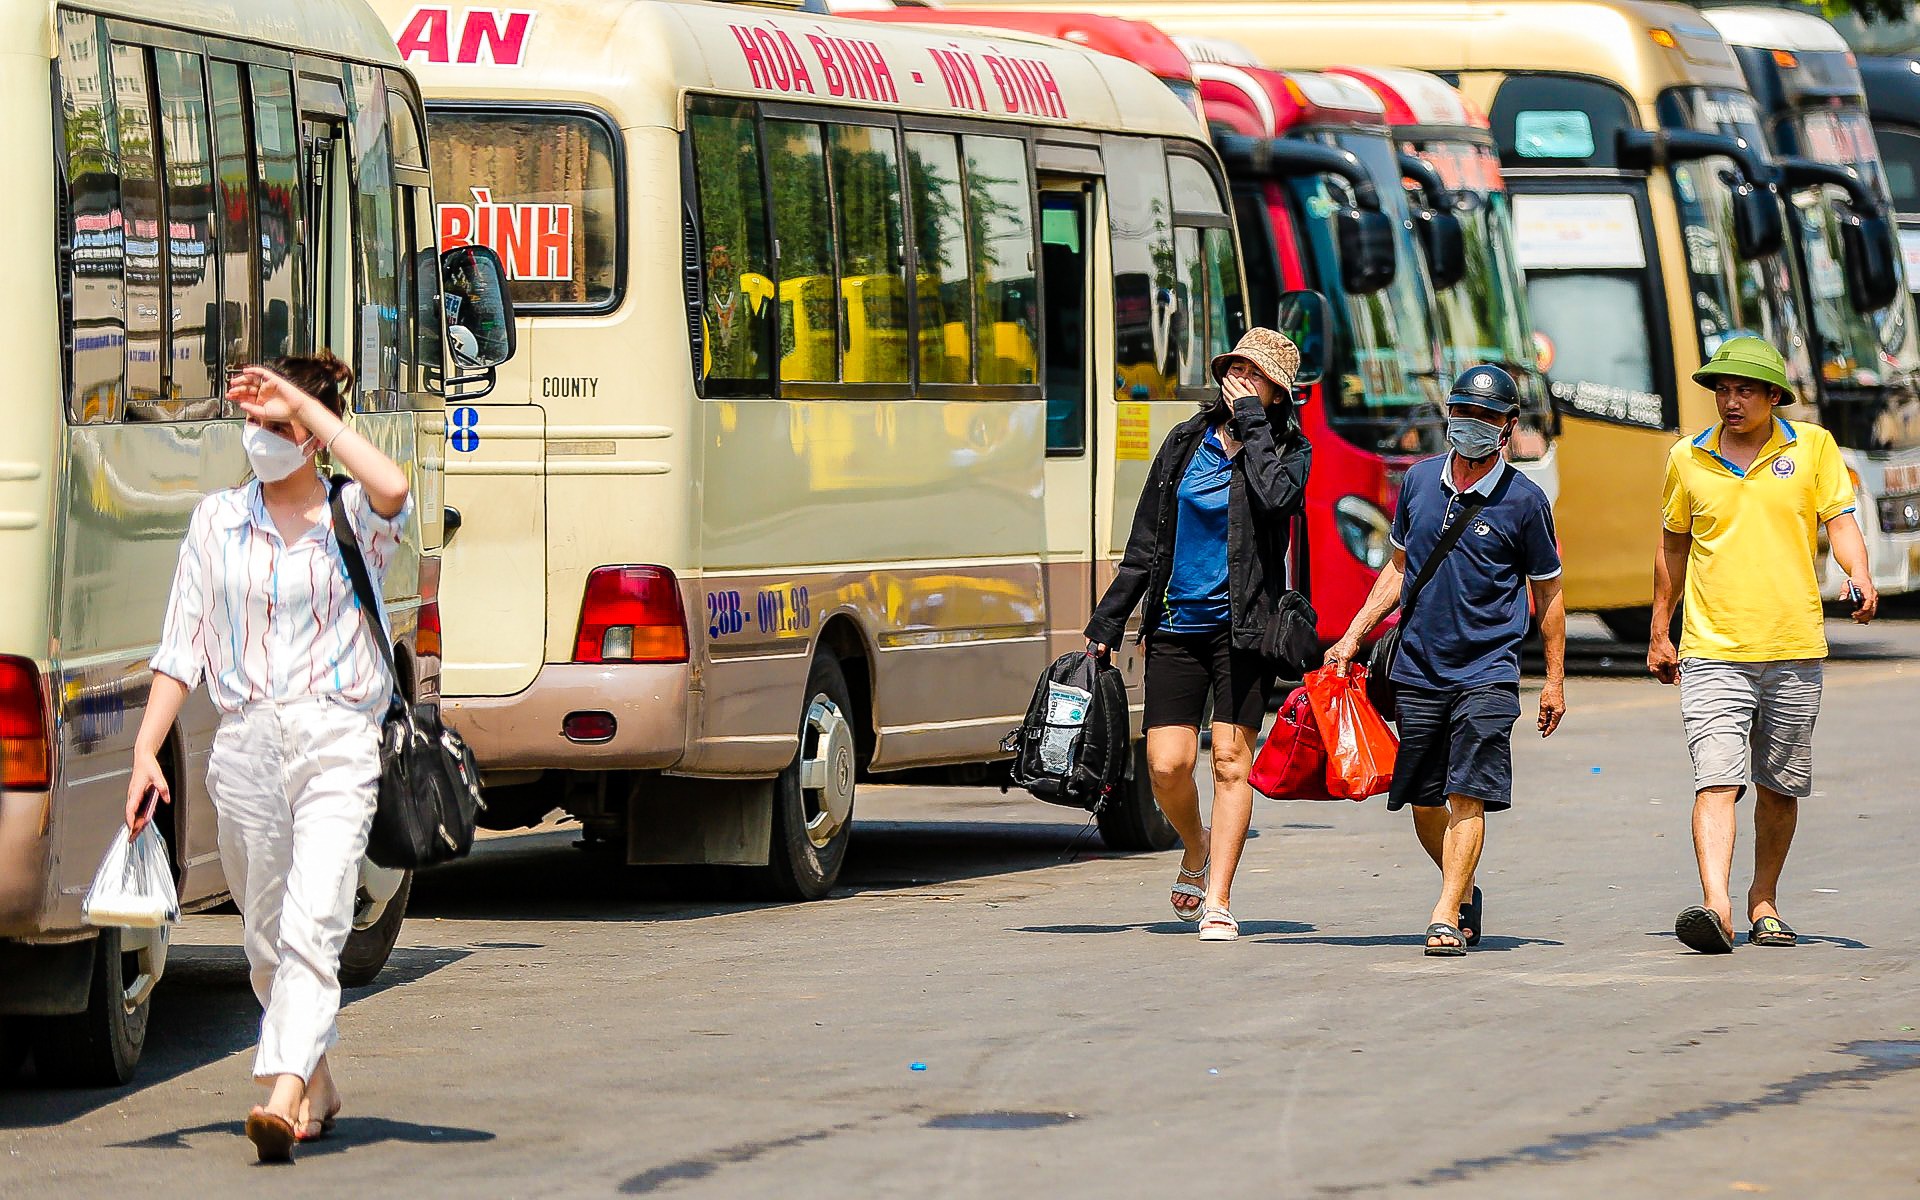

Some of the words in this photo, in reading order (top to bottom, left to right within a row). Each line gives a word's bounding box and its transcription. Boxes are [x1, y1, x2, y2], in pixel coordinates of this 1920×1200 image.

[396, 8, 530, 66] AN
[728, 19, 815, 95] HOÀ
[805, 25, 899, 104] BÌNH
[982, 45, 1069, 119] ĐÌNH
[439, 189, 571, 279] BÌNH
[543, 377, 599, 398] COUNTY
[445, 407, 480, 453] 8
[758, 586, 810, 634] 001.98
